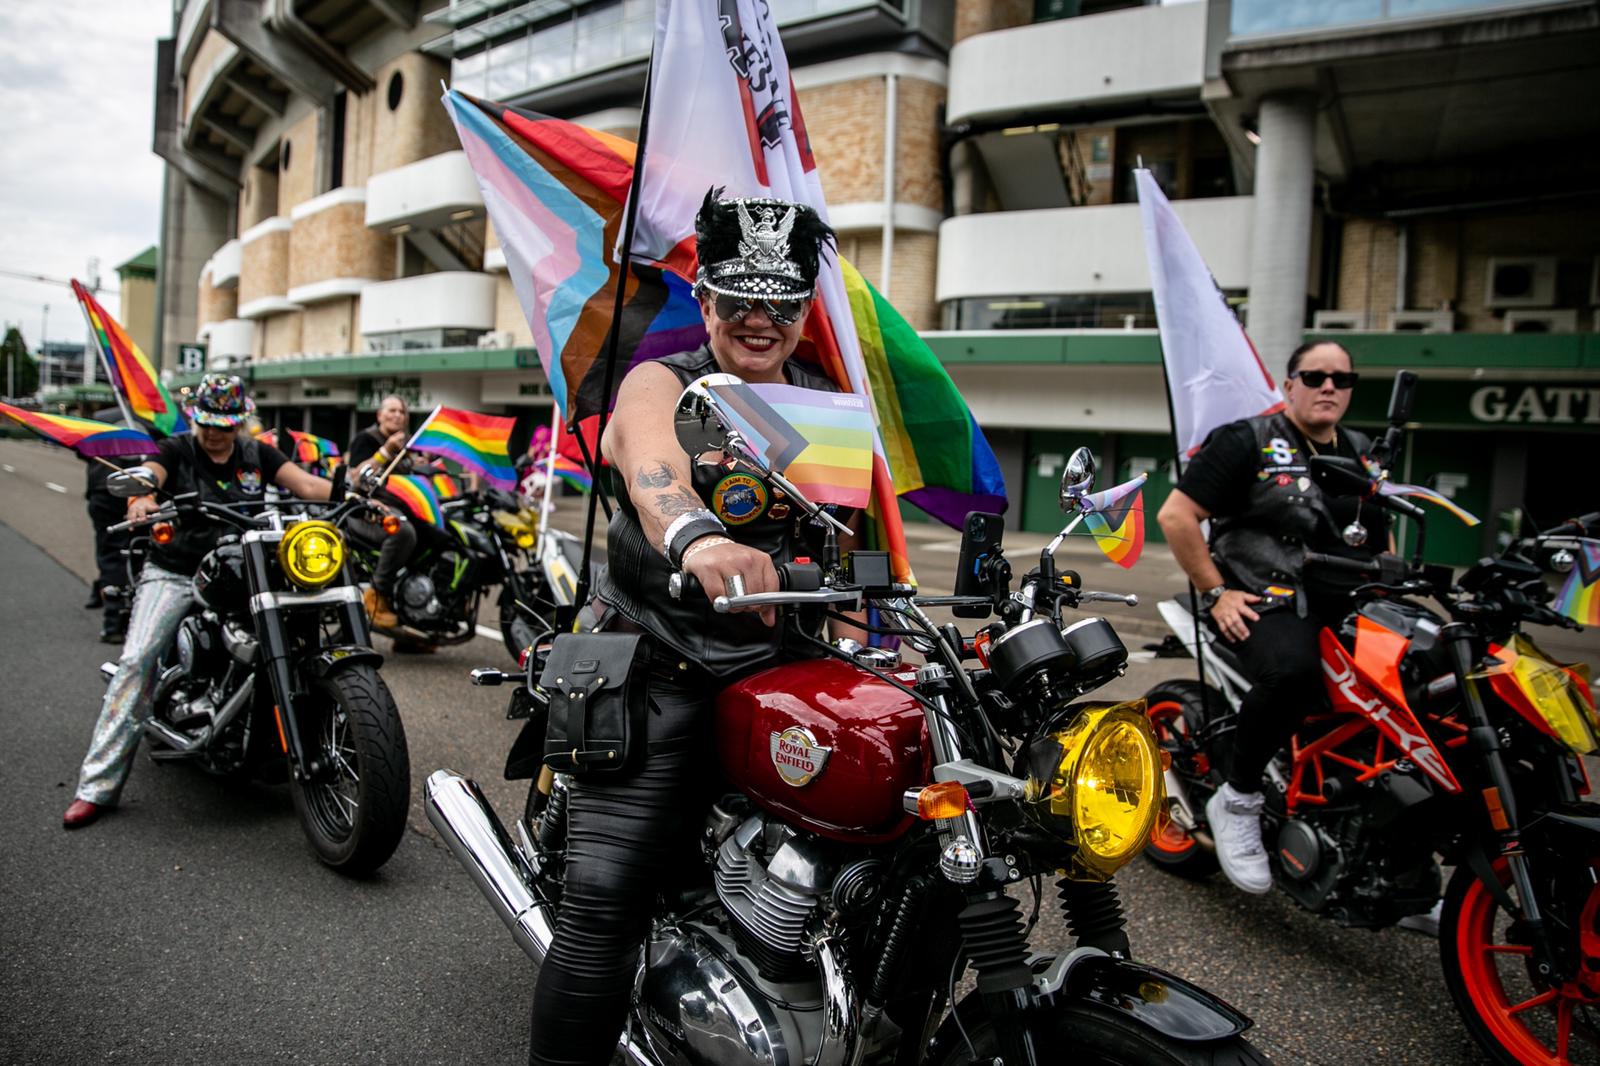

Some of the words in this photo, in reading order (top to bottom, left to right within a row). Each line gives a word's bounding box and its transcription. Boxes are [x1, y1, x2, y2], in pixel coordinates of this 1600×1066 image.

[184, 348, 204, 372] B
[780, 739, 810, 758] ROYAL
[776, 751, 814, 772] ENFIELD
